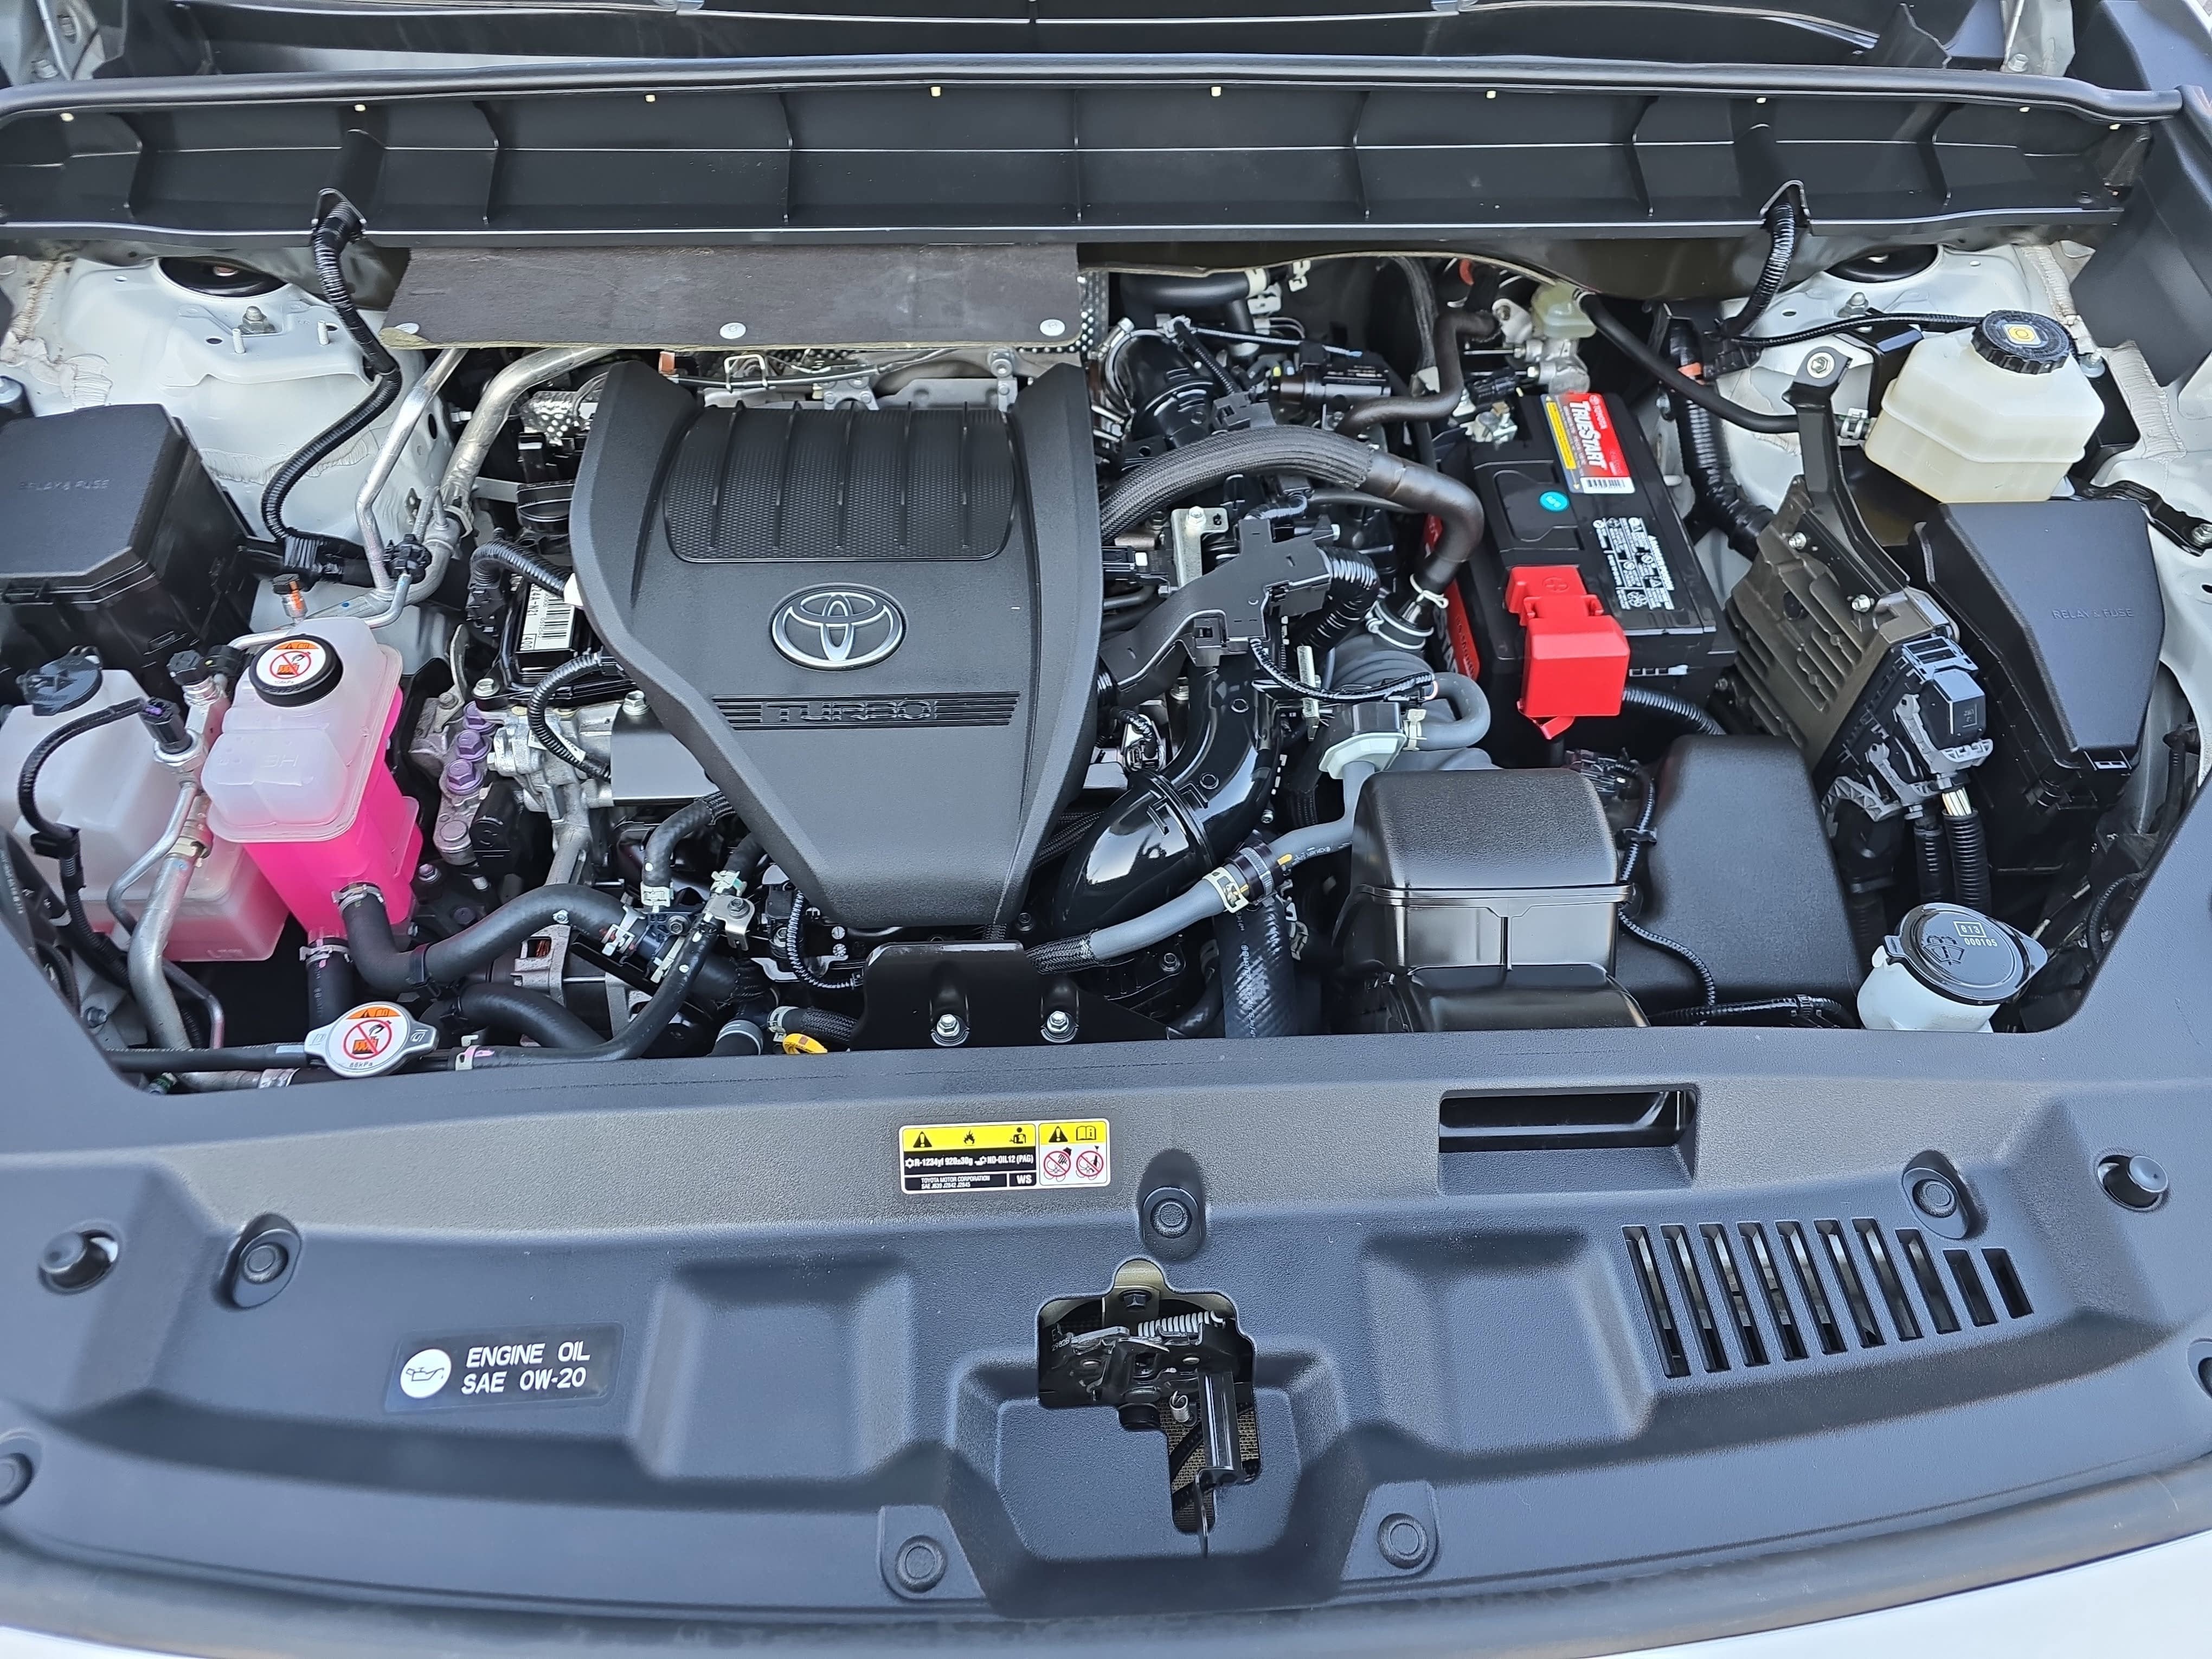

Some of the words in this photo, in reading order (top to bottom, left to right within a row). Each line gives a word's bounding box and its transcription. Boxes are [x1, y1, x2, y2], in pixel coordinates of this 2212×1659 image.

[2052, 609, 2089, 619] RELAY
[2102, 608, 2134, 618] FUSE
[766, 699, 931, 722] TURBO
[1964, 937, 1998, 947] 000105
[1016, 1154, 1034, 1165] (PAG)
[1016, 1174, 1032, 1185] WS
[466, 1343, 546, 1368] ENGINE
[558, 1341, 590, 1362] OIL
[461, 1371, 507, 1395] SAE
[519, 1367, 587, 1391] 0W-20
